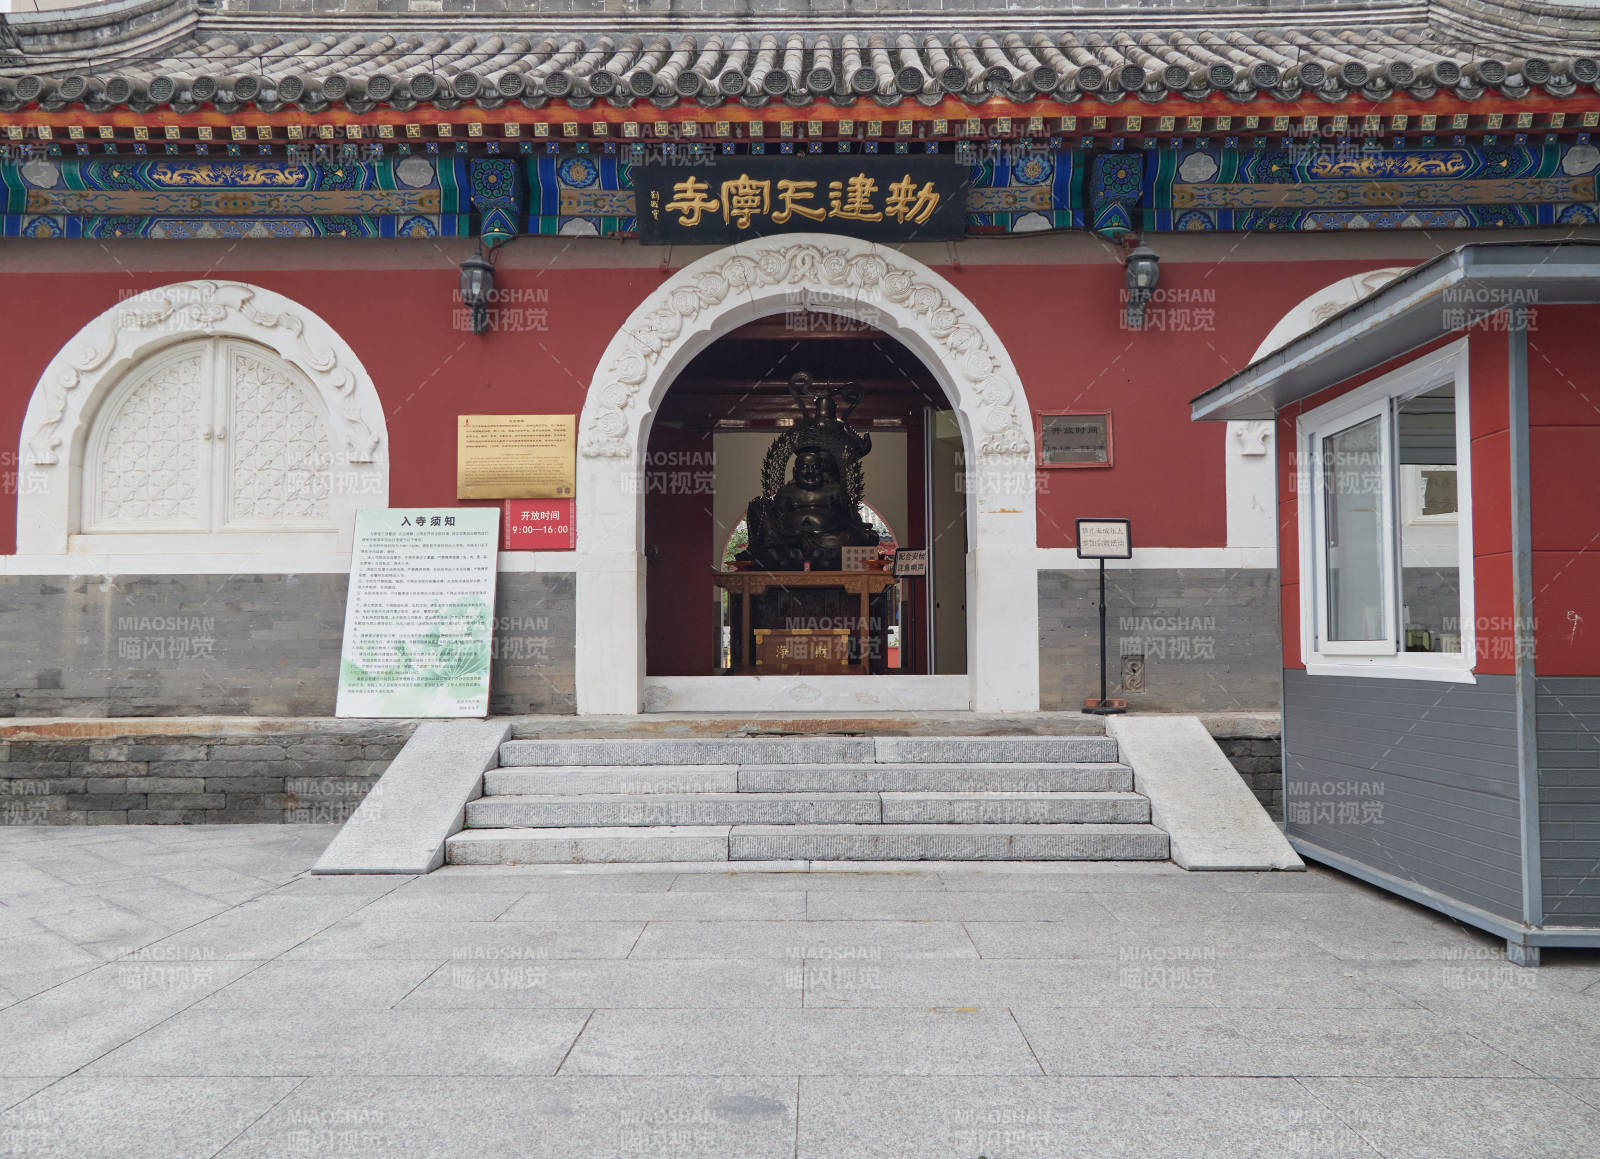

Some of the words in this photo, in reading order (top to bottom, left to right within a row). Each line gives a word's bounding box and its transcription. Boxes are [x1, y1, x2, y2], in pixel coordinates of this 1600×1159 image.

[520, 510, 560, 521] 开放时间
[401, 516, 456, 527] 入寺须知
